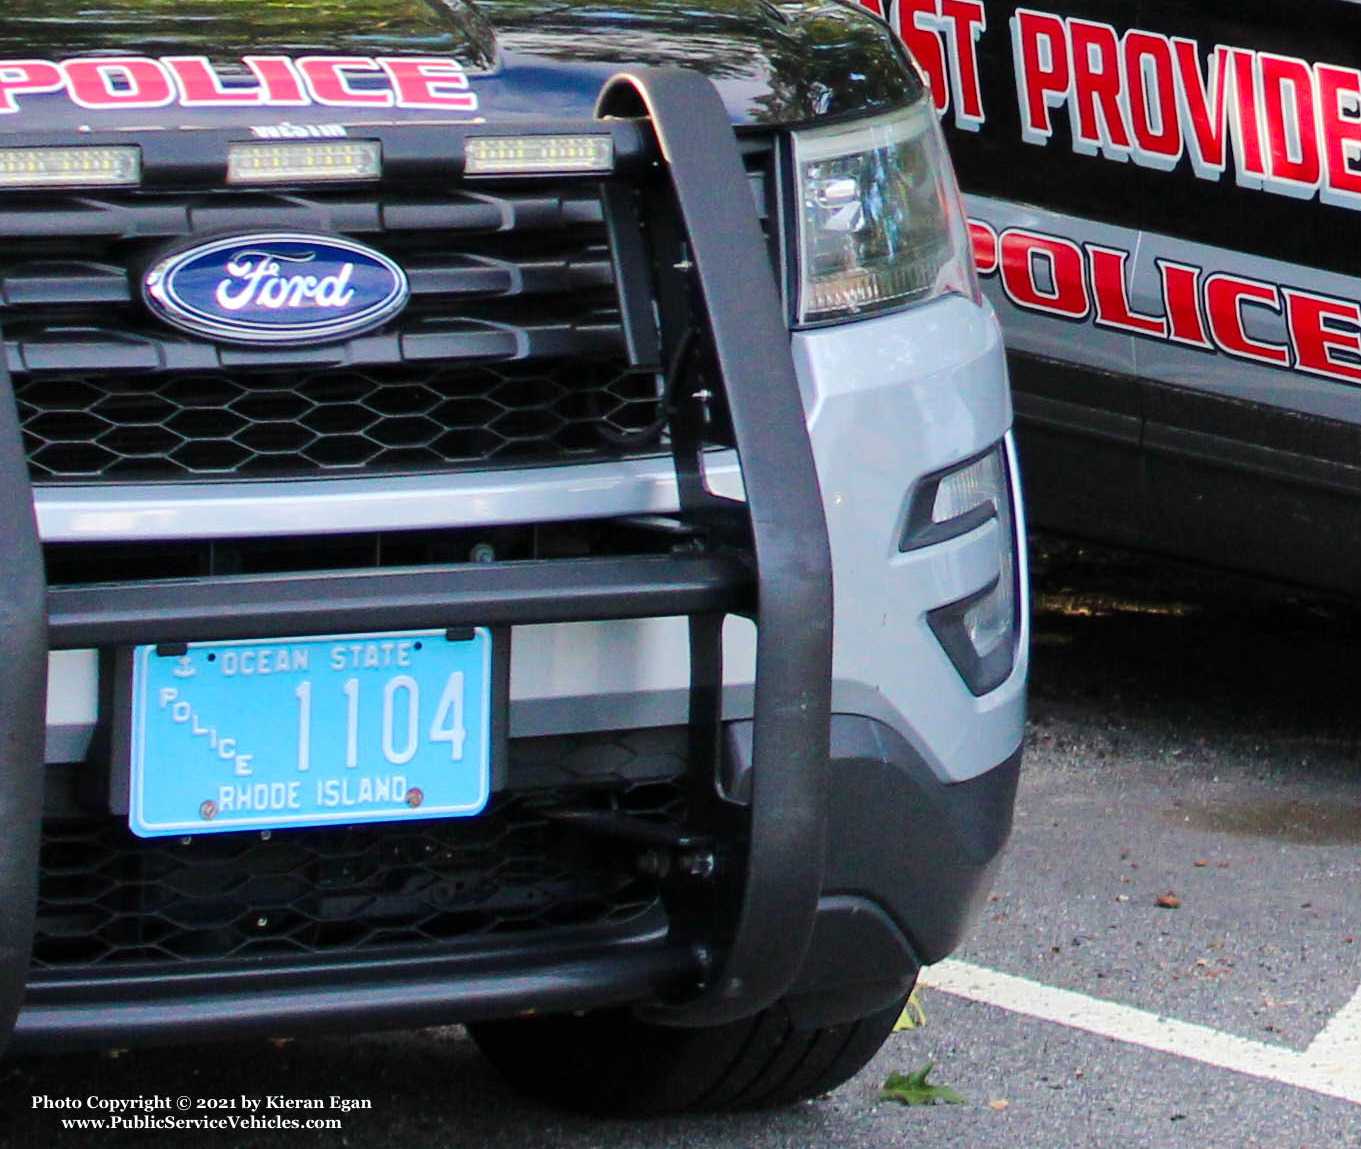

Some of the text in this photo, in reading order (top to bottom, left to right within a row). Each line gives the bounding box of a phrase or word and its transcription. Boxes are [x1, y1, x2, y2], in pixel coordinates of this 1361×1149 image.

[0, 56, 478, 114] POLICE
[215, 250, 356, 311] Ford
[220, 642, 412, 677] OCEAN STATE
[159, 687, 253, 776] POLICE
[295, 670, 467, 772] 1104
[218, 775, 409, 812] RHODE ISLAND
